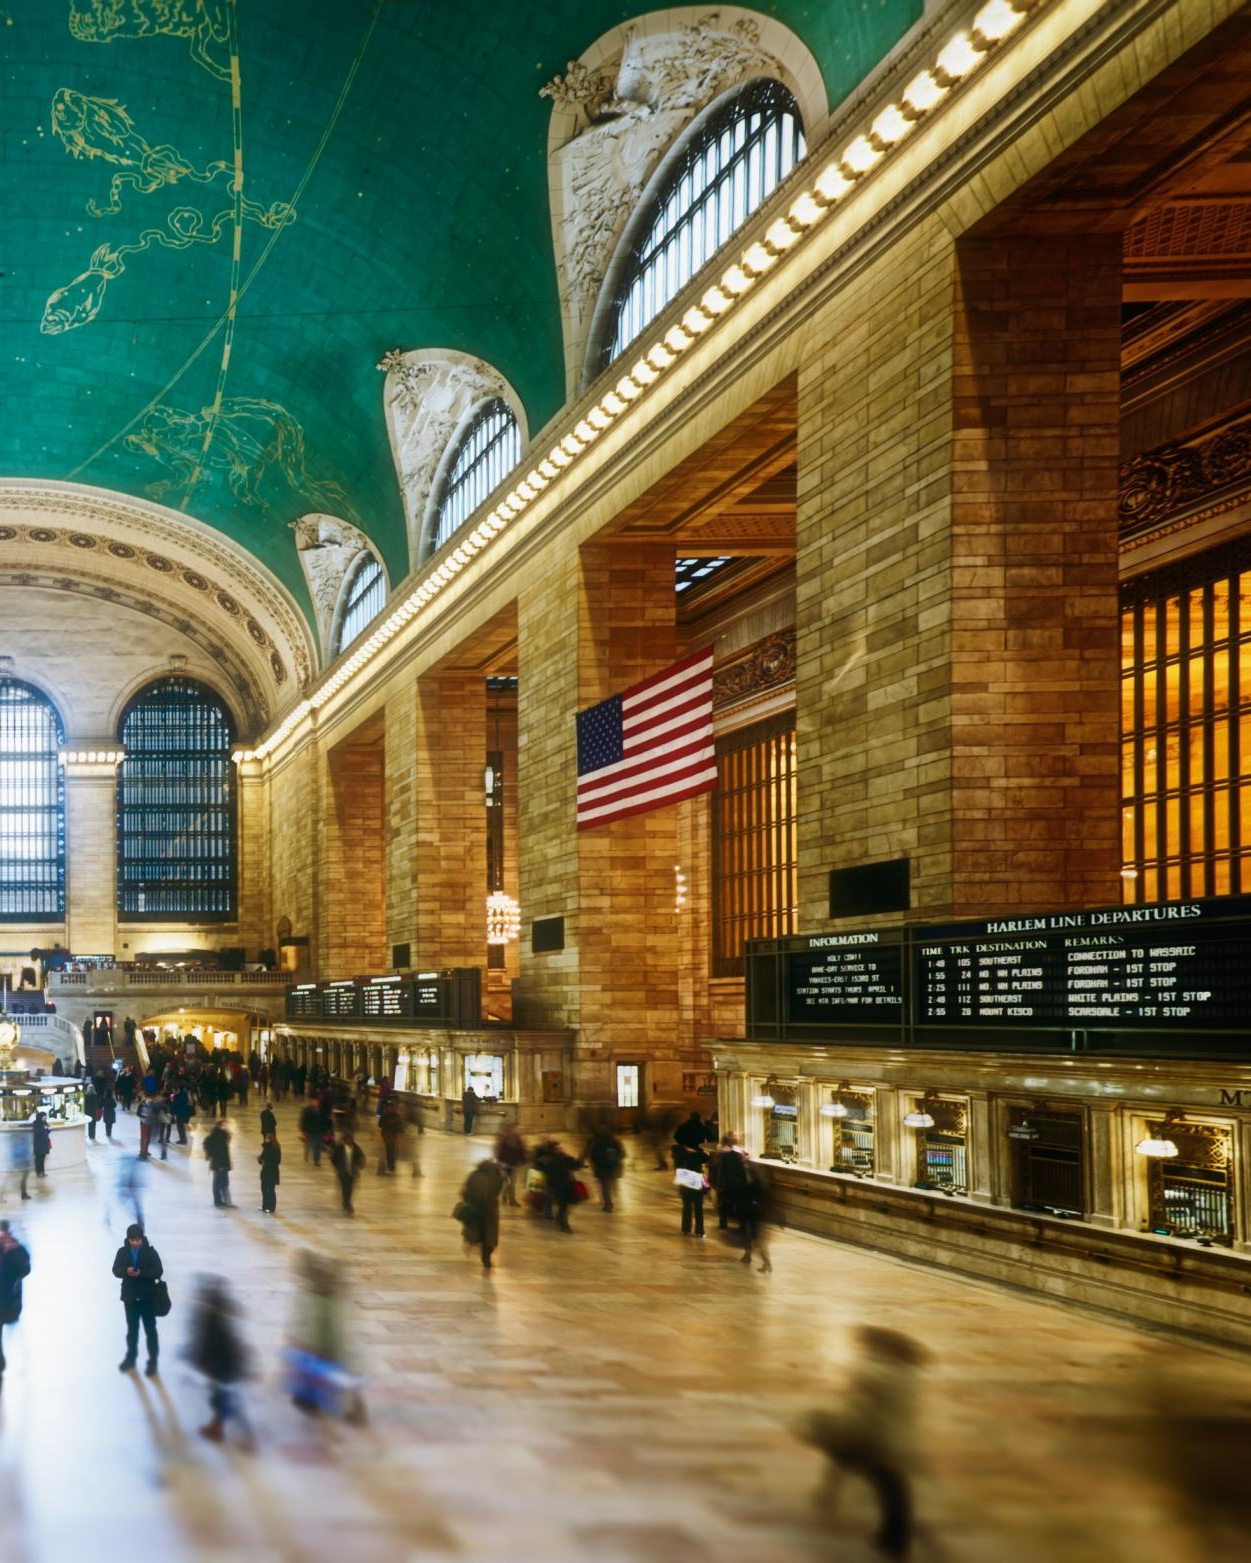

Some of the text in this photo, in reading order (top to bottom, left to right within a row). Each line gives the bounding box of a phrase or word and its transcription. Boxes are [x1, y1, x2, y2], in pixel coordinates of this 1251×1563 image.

[987, 904, 1201, 934] HARLEM LINE DEPARTURES
[809, 933, 879, 948] INFORMATION
[922, 935, 1125, 956] TIME TRK DESTINATION REMARKS
[827, 954, 841, 962] HOLY
[957, 958, 971, 967] 105
[978, 955, 1022, 966] SOUTHEAST
[1067, 949, 1127, 962] CONNECTION
[1132, 948, 1144, 959] TO
[1149, 946, 1196, 957] WASSAIC
[811, 963, 877, 973] GAME-DAY SERVICE TO
[961, 970, 971, 979] 24
[1011, 967, 1043, 977] PLAINS
[1067, 965, 1108, 975] FORDHAM
[1126, 963, 1144, 973] 1ST
[1149, 962, 1177, 972] STOP
[871, 974, 880, 982] ST
[958, 983, 970, 991] 111
[1011, 981, 1043, 990] PLAINS
[1067, 979, 1108, 989] FORDHAM
[1126, 978, 1144, 988] 1ST
[1149, 977, 1177, 987] STOP
[796, 987, 819, 995] STATION
[821, 986, 842, 994] STARTS
[868, 985, 886, 993] APRIL
[875, 996, 902, 1004] DETAILS
[958, 995, 972, 1004] 112
[979, 994, 1023, 1004] SOUTHEAST
[1068, 993, 1097, 1003] WHITE
[1101, 992, 1139, 1003] PLAINS
[1157, 992, 1177, 1002] 1ST
[1182, 991, 1212, 1001] STOP
[979, 1007, 1003, 1016] MOUNT
[1007, 1007, 1033, 1016] KISCO
[1068, 1007, 1120, 1017] SCARSDALE
[1138, 1007, 1157, 1017] 1ST
[1163, 1007, 1191, 1016] STOP
